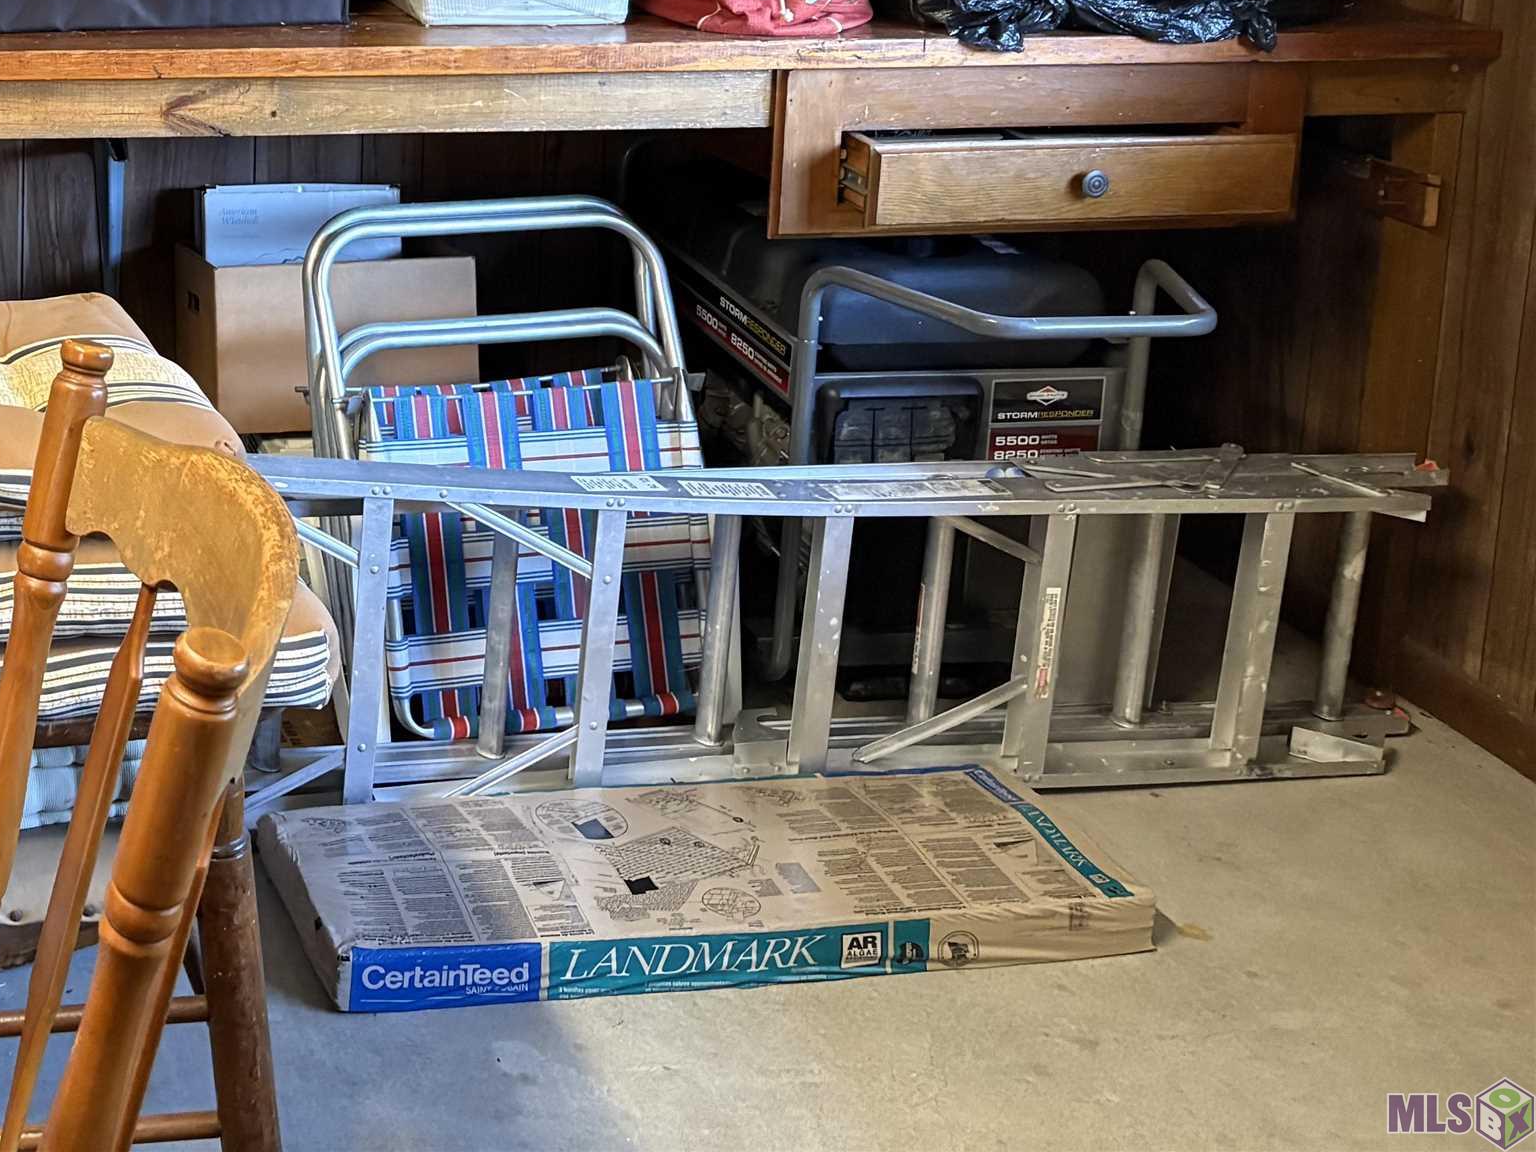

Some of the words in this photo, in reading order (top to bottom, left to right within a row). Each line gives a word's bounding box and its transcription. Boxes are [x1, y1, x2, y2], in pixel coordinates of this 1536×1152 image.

[730, 332, 755, 360] 8250
[997, 409, 1094, 420] STORMRESPONDER
[995, 435, 1040, 446] 5500
[994, 449, 1039, 461] 8250
[847, 935, 878, 951] AR
[559, 934, 826, 980] LANDMARK
[847, 949, 878, 957] ALGAE
[361, 962, 530, 990] CertainTeed
